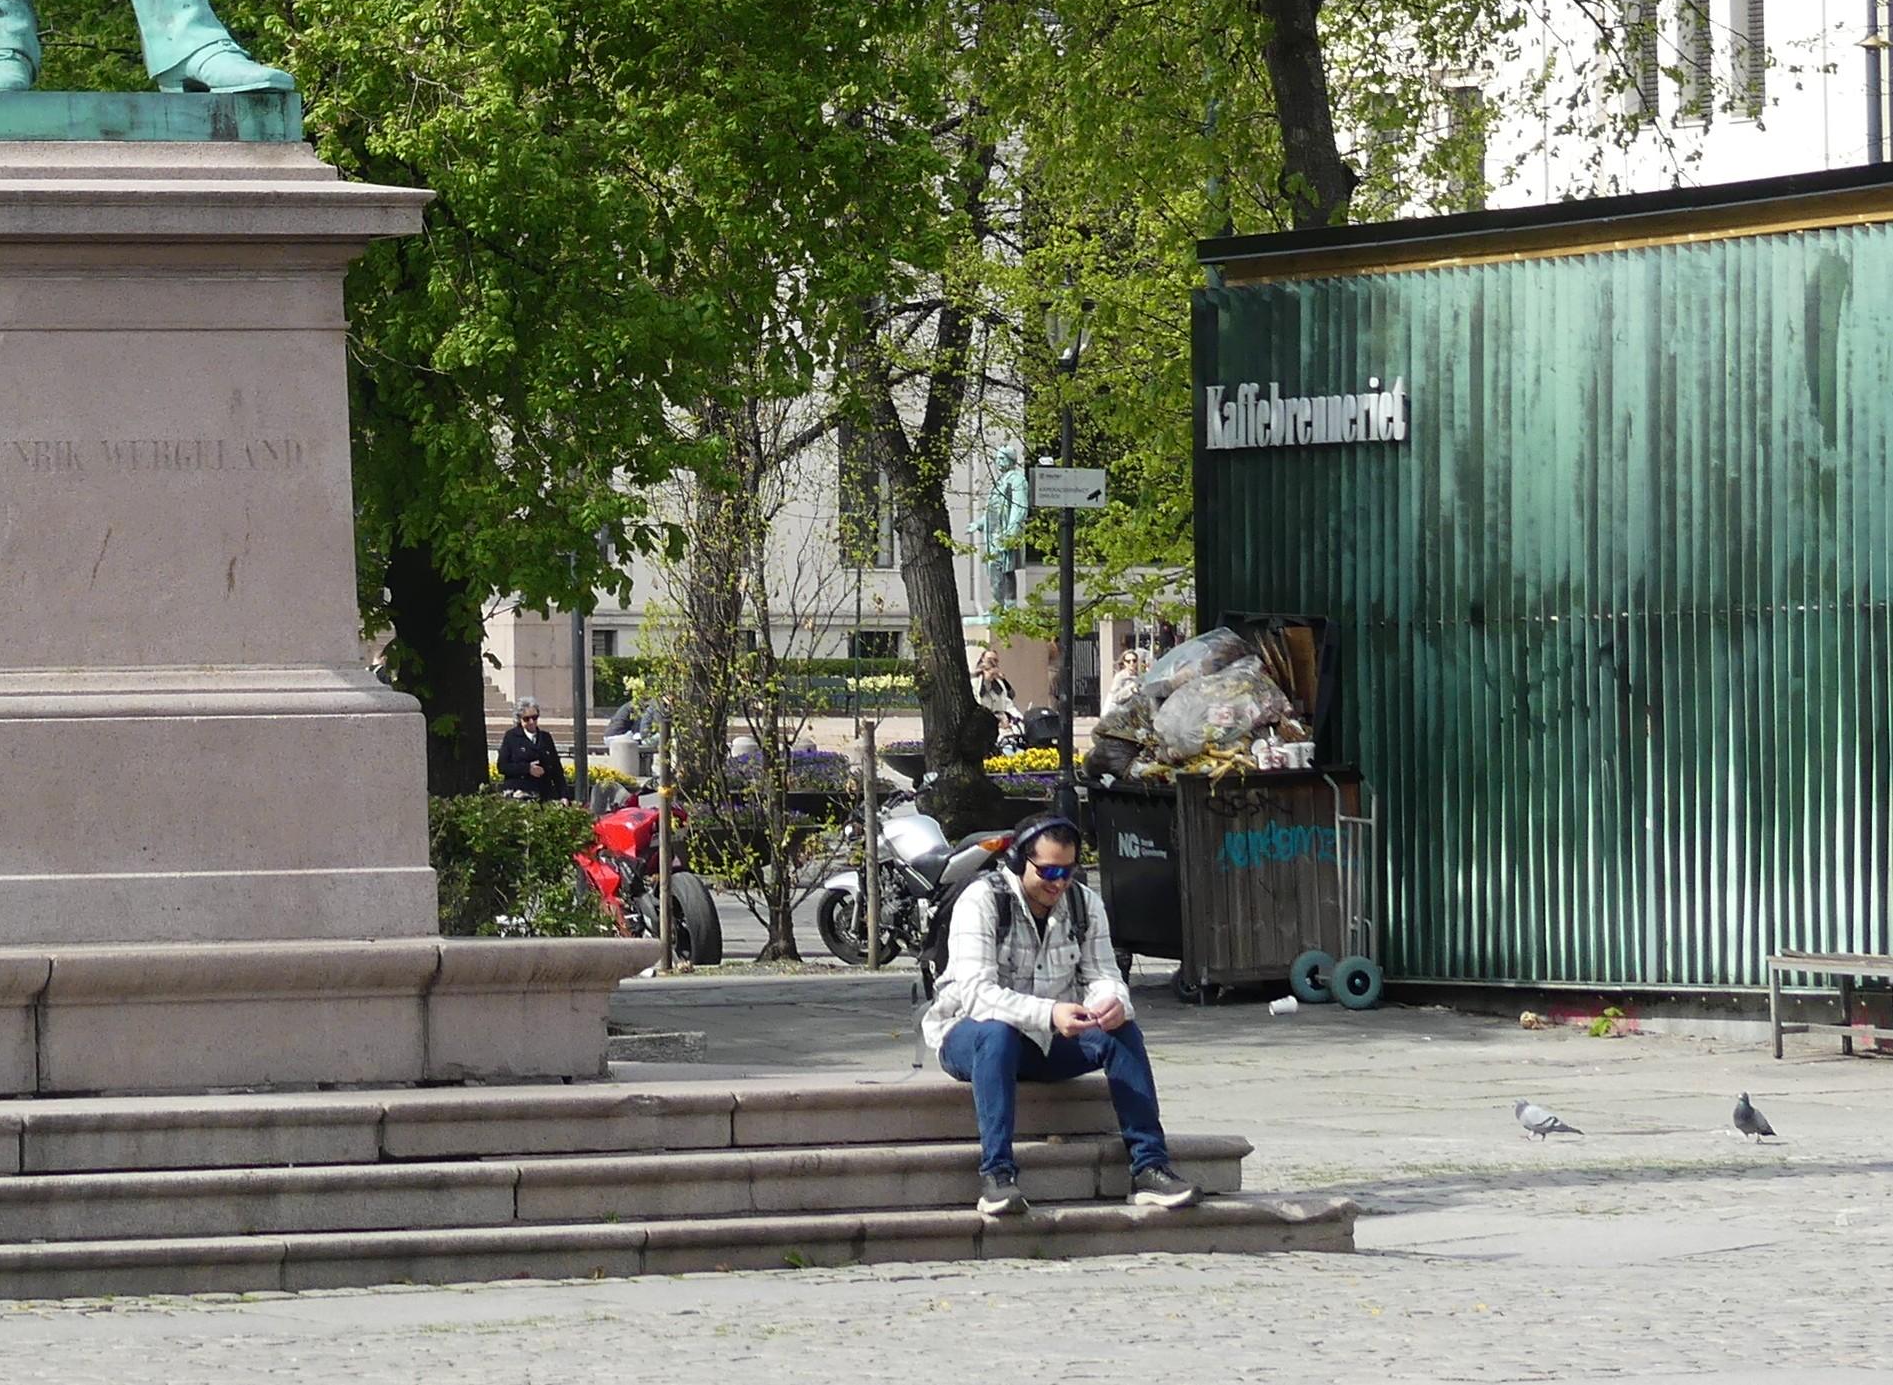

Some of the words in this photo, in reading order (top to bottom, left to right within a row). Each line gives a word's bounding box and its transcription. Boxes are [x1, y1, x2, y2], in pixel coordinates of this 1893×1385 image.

[1206, 376, 1405, 449] Kaffebrenneriet
[101, 438, 303, 473] WERGELAND
[1118, 831, 1140, 858] NG
